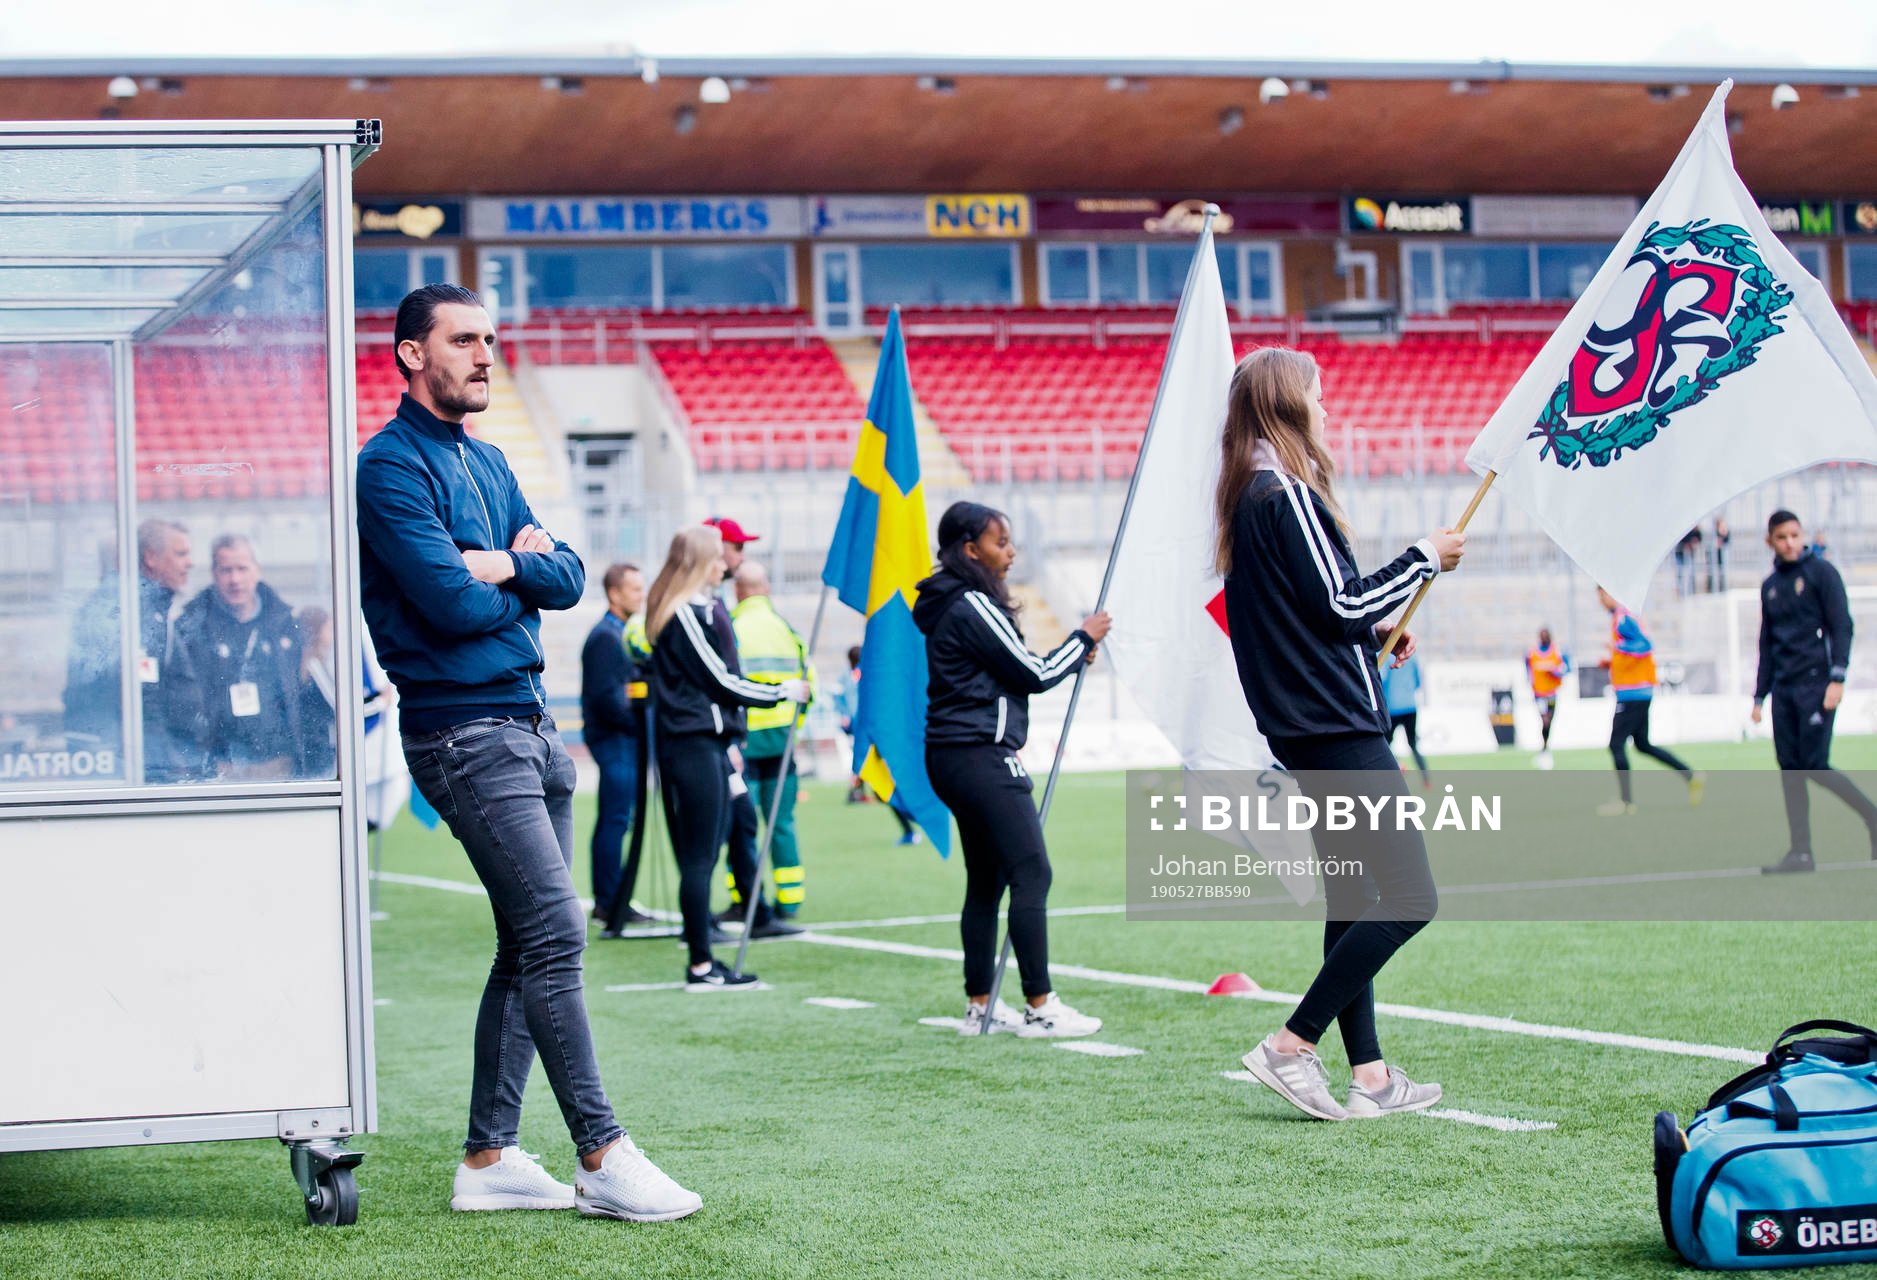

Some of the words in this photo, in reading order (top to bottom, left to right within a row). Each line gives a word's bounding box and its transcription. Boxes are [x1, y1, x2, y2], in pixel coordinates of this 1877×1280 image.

[505, 201, 769, 232] MALMBERGS
[935, 202, 1020, 229] NCH
[1797, 1216, 1877, 1247] ÖREB
